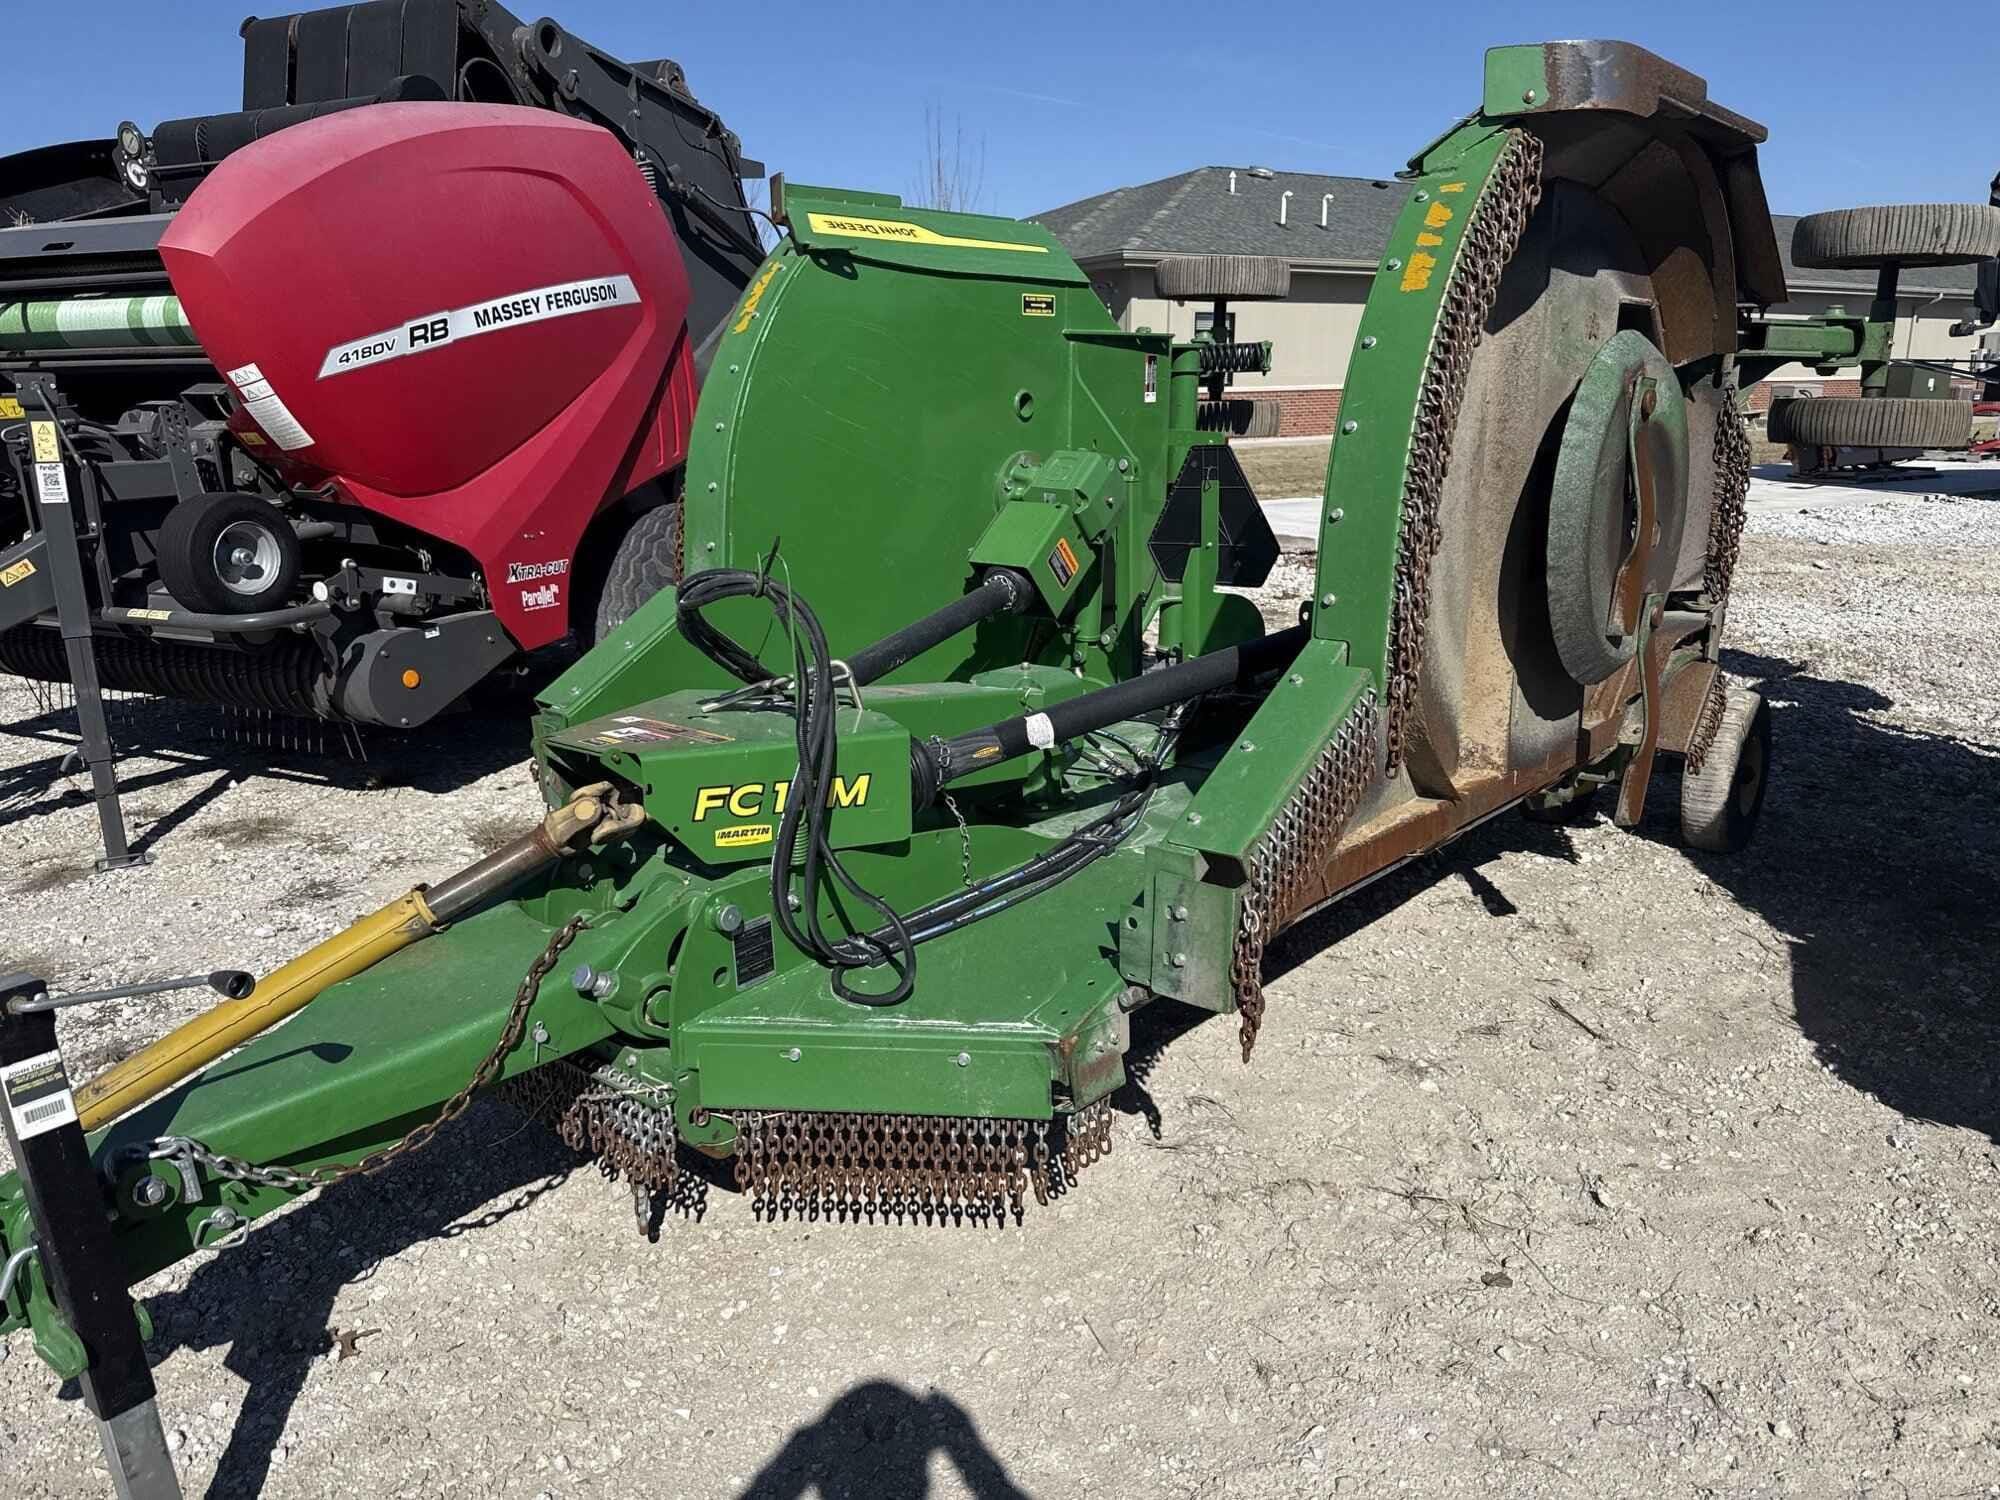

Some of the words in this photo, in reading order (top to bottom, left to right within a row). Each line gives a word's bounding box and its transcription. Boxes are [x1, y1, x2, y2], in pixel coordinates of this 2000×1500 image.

[823, 219, 880, 235] DEERE
[880, 223, 918, 238] JOHN
[338, 338, 397, 365] 4180V
[408, 317, 450, 348] RB
[473, 296, 541, 329] MASSEY
[545, 283, 618, 312] FERGUSON
[506, 558, 569, 584] XTRA-CUT
[691, 783, 766, 823] FC
[773, 773, 872, 815] 1M
[719, 826, 771, 840] MARTIN
